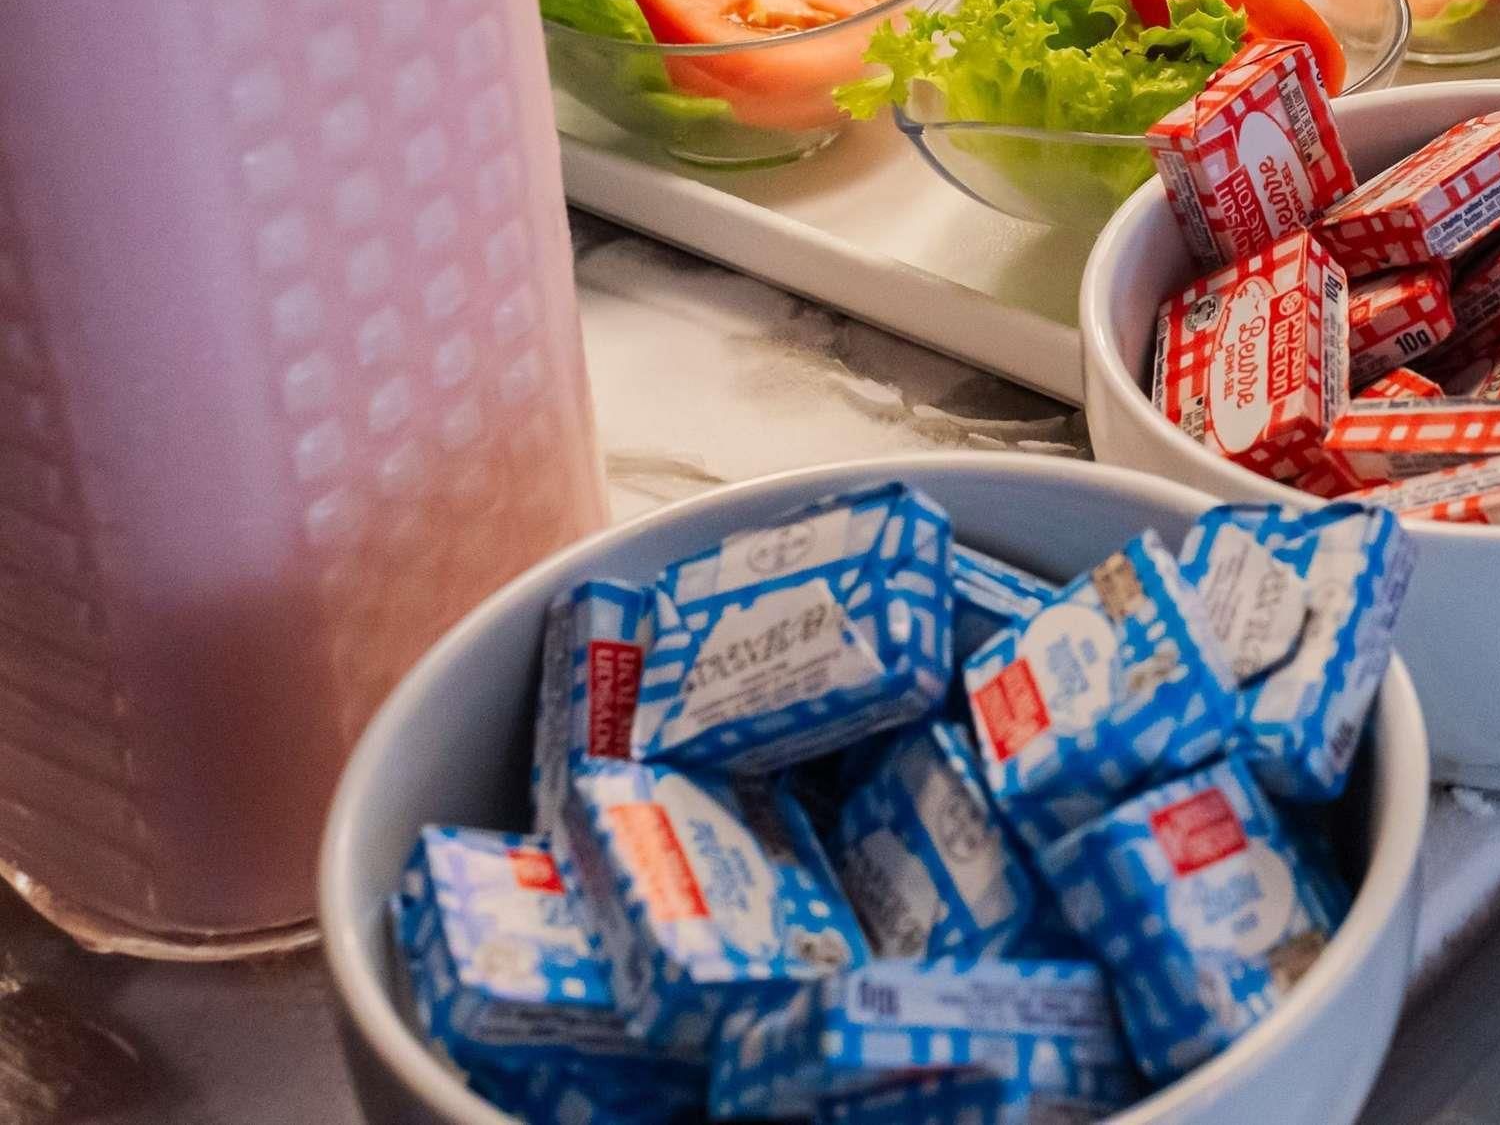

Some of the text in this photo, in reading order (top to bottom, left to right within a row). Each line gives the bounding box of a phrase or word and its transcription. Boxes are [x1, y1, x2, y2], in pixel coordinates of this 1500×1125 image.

[1232, 175, 1265, 249] RETON
[1325, 275, 1343, 303] 10g
[1236, 315, 1266, 409] Beurre
[1394, 329, 1431, 355] 10g
[1223, 343, 1235, 401] DEMI-SEL
